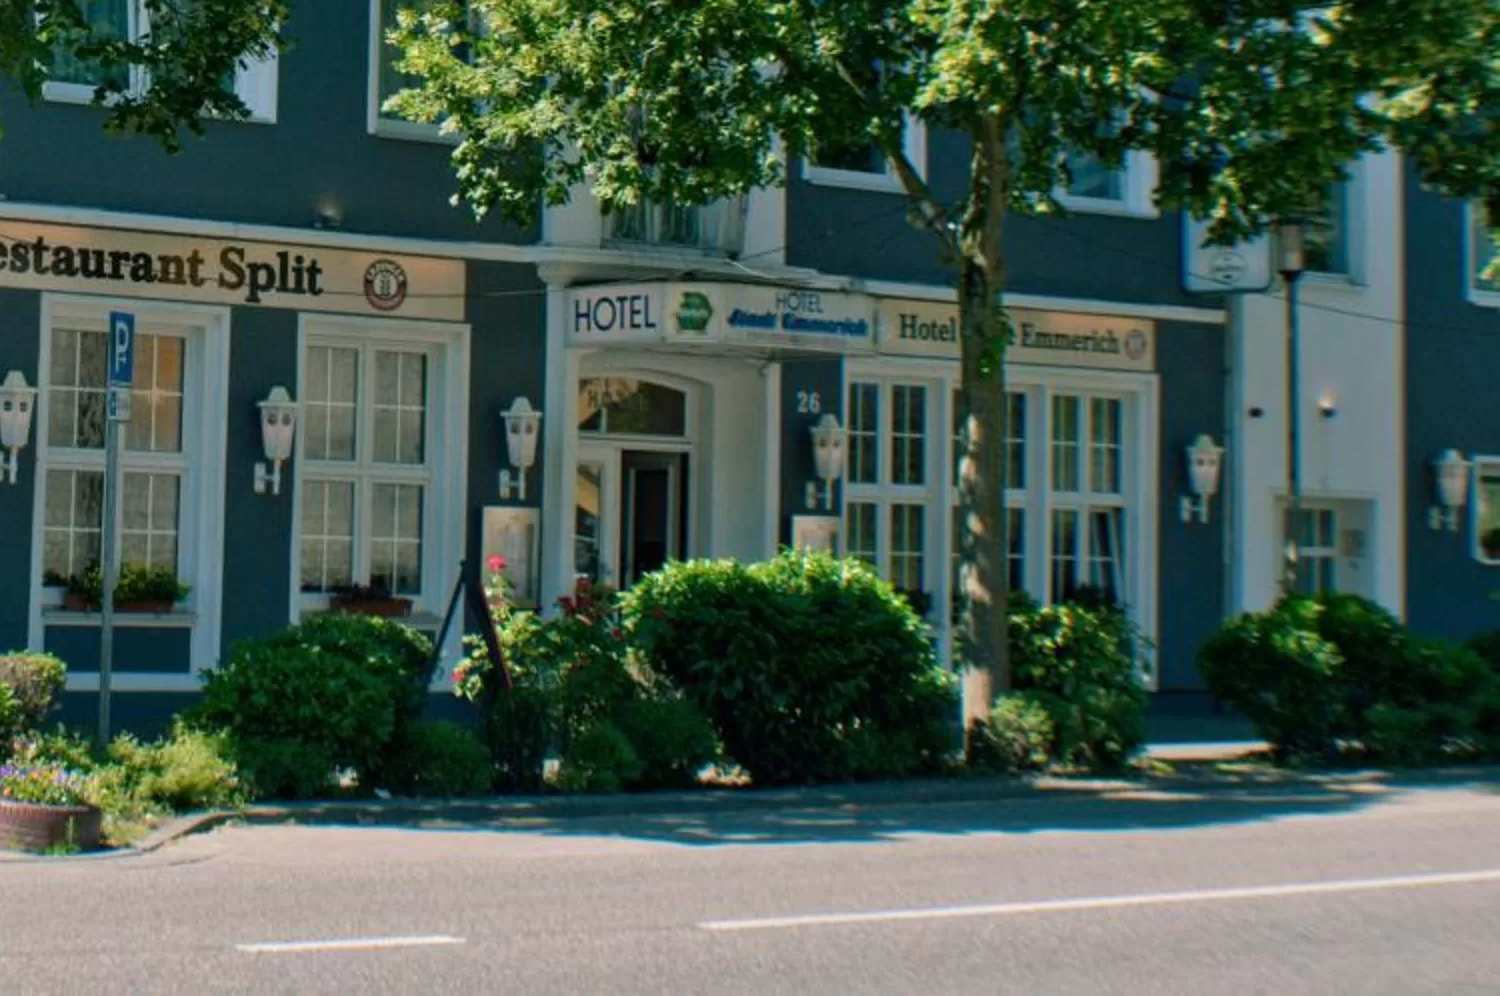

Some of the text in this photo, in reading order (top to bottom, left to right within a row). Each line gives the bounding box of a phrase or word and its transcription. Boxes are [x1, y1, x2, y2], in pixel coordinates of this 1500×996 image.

[218, 245, 323, 302] Split
[574, 294, 657, 333] HOTEL
[775, 290, 824, 314] HOTEL
[900, 313, 957, 343] Hotel
[796, 390, 822, 414] 26
